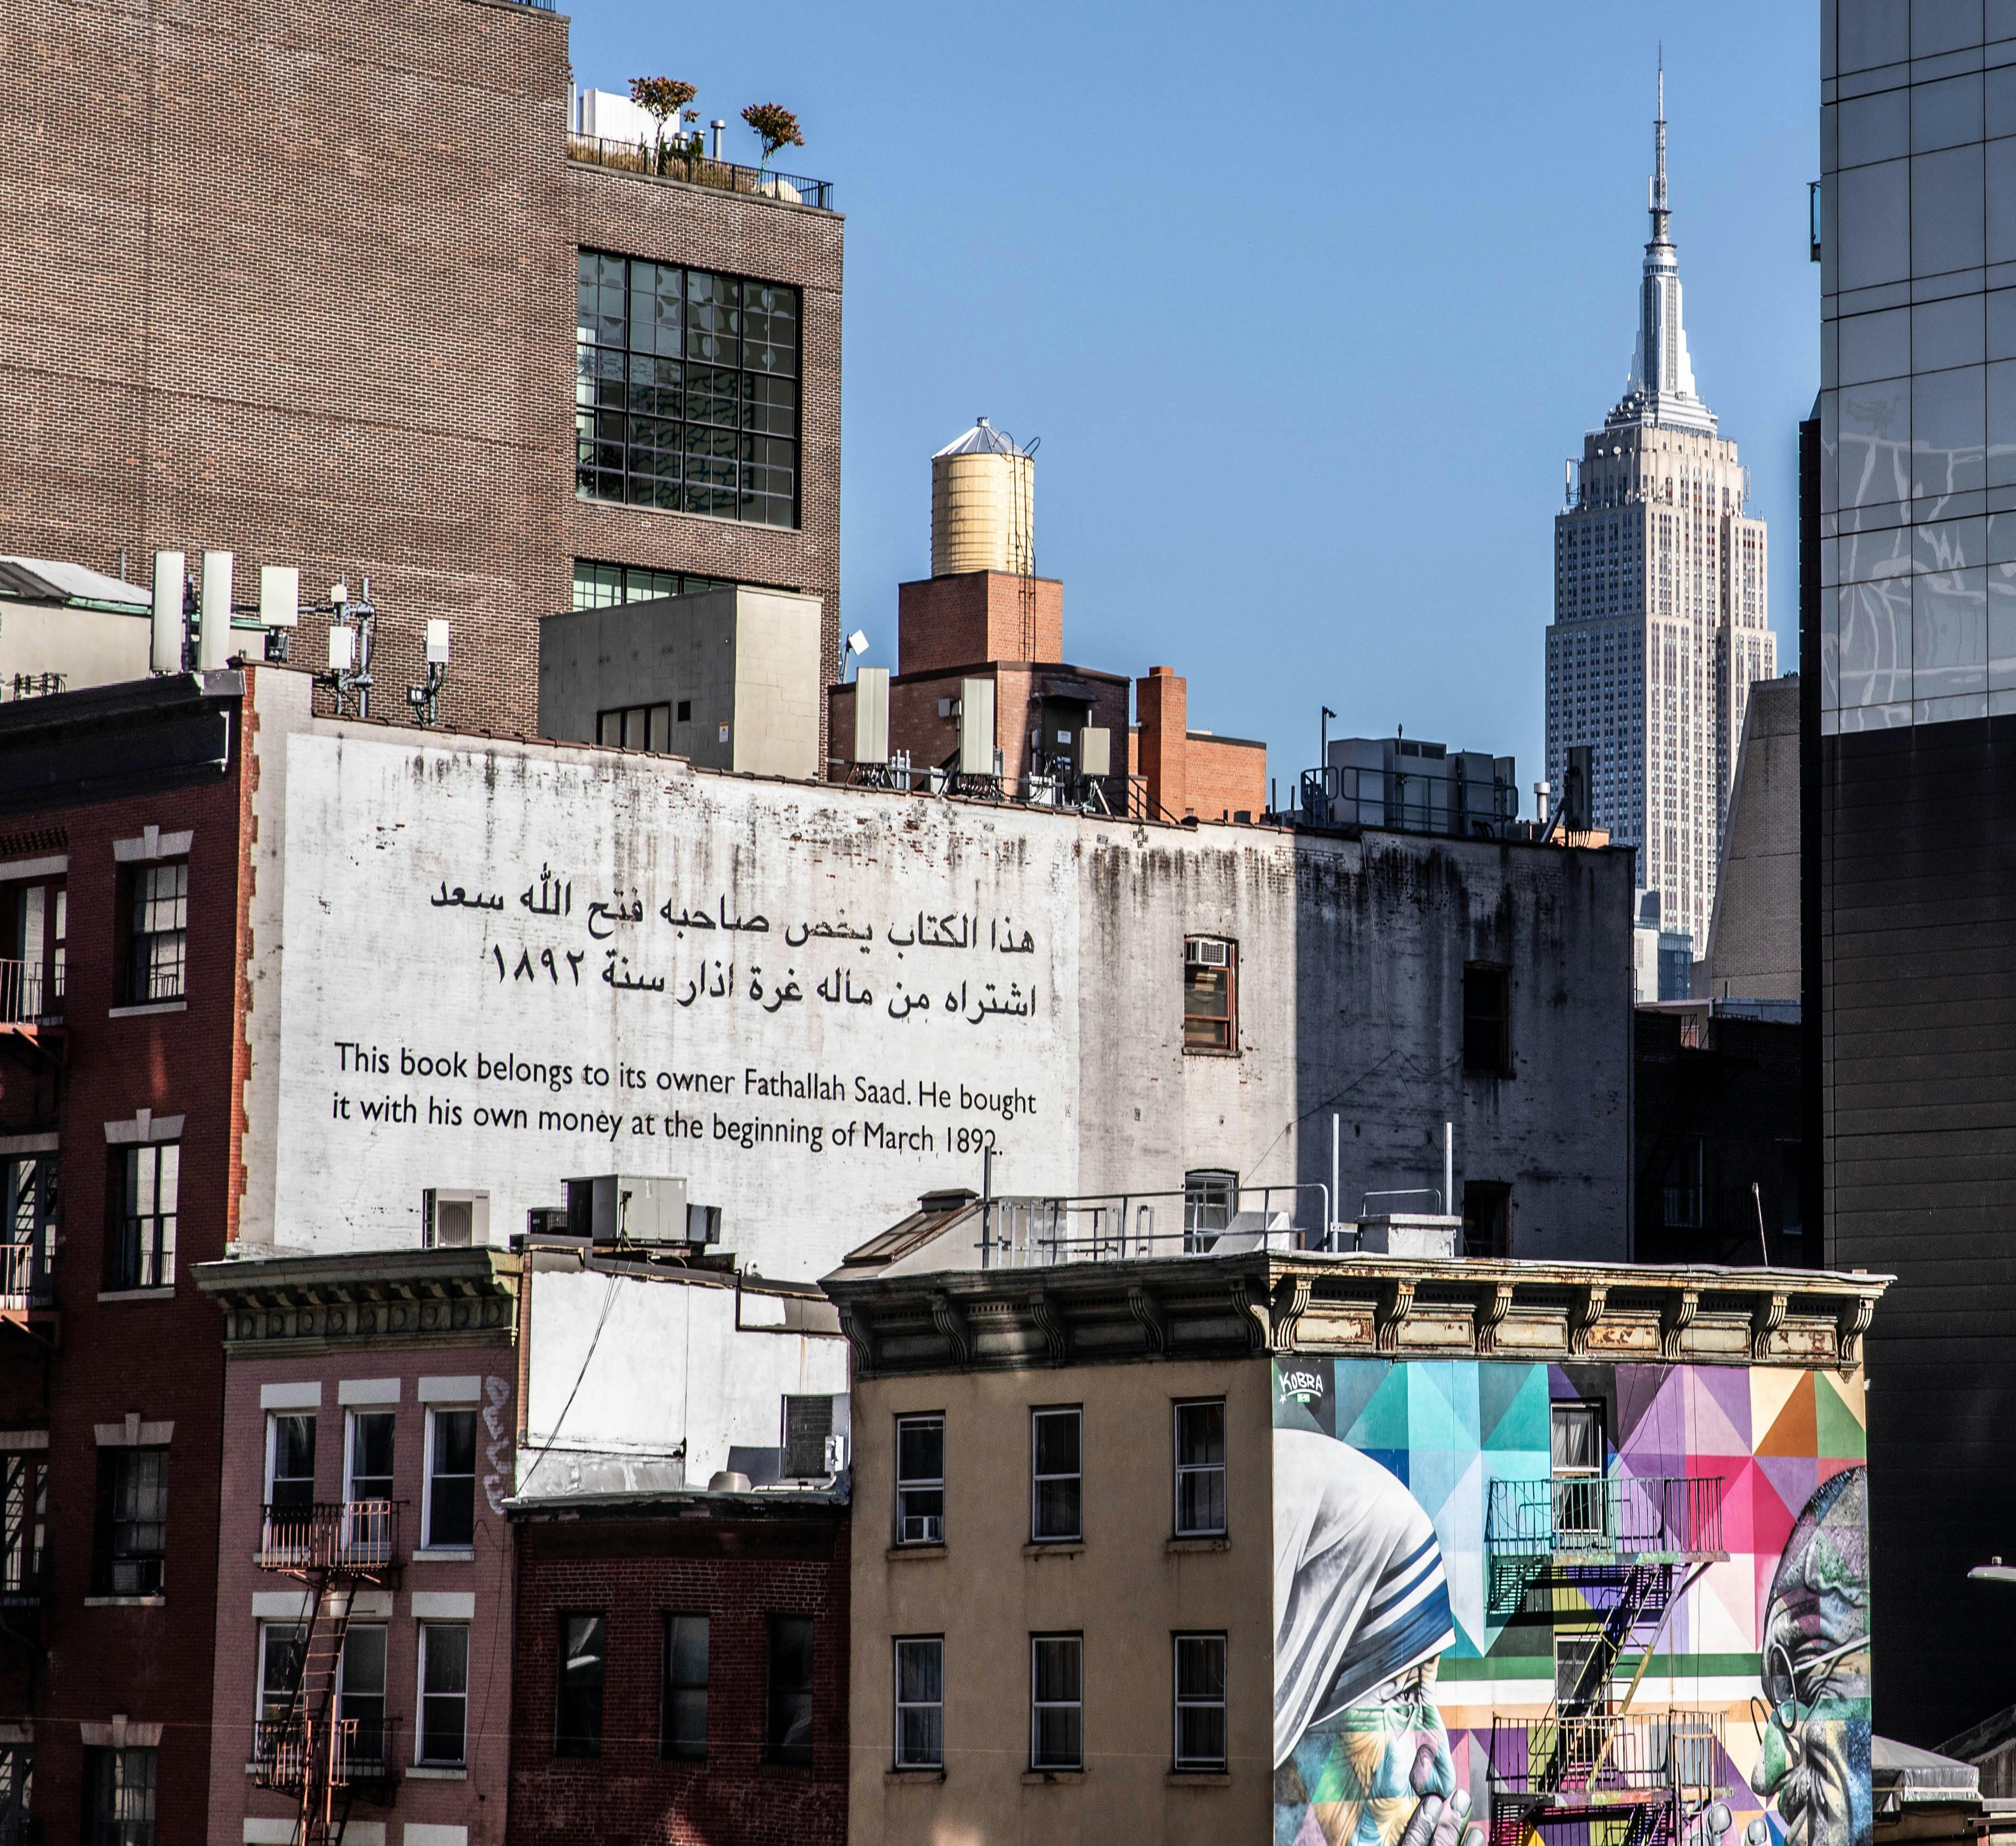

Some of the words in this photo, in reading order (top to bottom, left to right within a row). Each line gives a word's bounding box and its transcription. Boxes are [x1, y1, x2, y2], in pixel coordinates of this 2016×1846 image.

[431, 881, 504, 910] سعد
[588, 886, 643, 940] فتح
[660, 894, 769, 939] صاحبه
[785, 909, 873, 955] يخص
[887, 911, 977, 959] الكتاب
[991, 916, 1034, 954] هذا
[493, 944, 584, 986] ١٨٩٢
[602, 949, 664, 992] سنة
[677, 960, 734, 1007] اذار
[817, 967, 872, 1005] ماله
[749, 966, 803, 1013] غرة
[888, 982, 930, 1018] من
[945, 981, 1036, 1024] اشتراه
[334, 1041, 389, 1074] This
[401, 1047, 467, 1077] book
[478, 1052, 573, 1092] belongs
[583, 1064, 609, 1086] to
[620, 1067, 646, 1089] its
[656, 1072, 735, 1094] owner
[745, 1068, 845, 1101] Fathallah
[855, 1076, 912, 1105] Saad.
[919, 1081, 950, 1108] He
[960, 1084, 1037, 1121] bought
[333, 1092, 350, 1120] it
[360, 1094, 417, 1123] with
[428, 1096, 462, 1126] his
[473, 1108, 527, 1129] own
[539, 1111, 623, 1142] money
[632, 1114, 655, 1136] at
[664, 1110, 703, 1139] the
[713, 1113, 823, 1153] beginning
[832, 1121, 856, 1146] of
[864, 1121, 933, 1151] March
[947, 1127, 1003, 1156] 1892.
[1278, 1371, 1323, 1392] KOBRA
